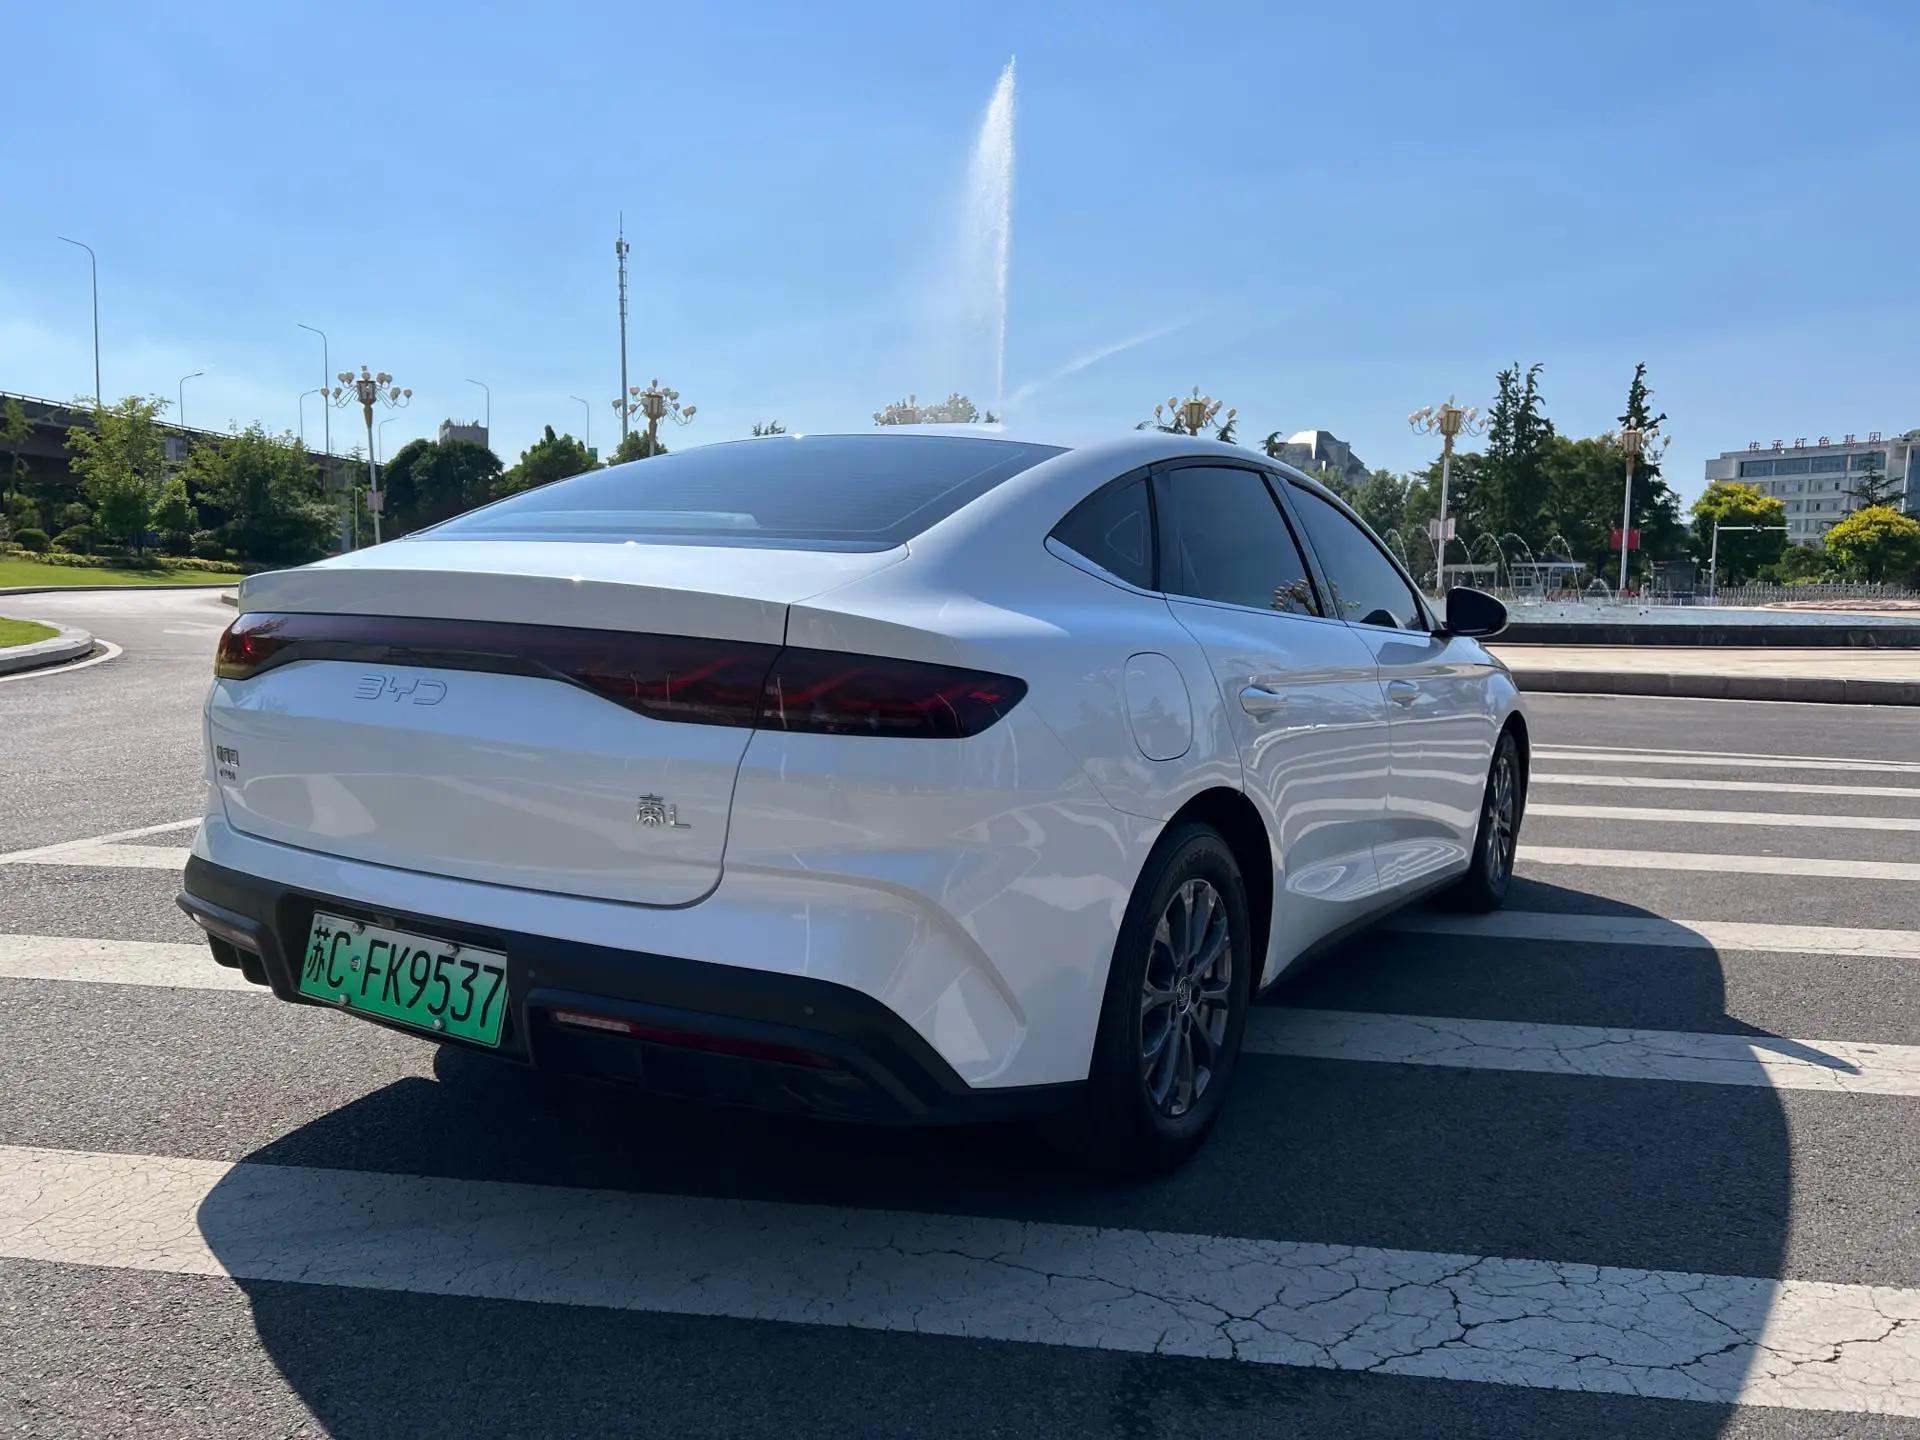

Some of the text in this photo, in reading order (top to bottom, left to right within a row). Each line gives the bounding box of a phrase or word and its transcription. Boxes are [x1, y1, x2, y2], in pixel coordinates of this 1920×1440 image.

[1748, 431, 1882, 453] 传承红色基因
[354, 674, 448, 706] BYD
